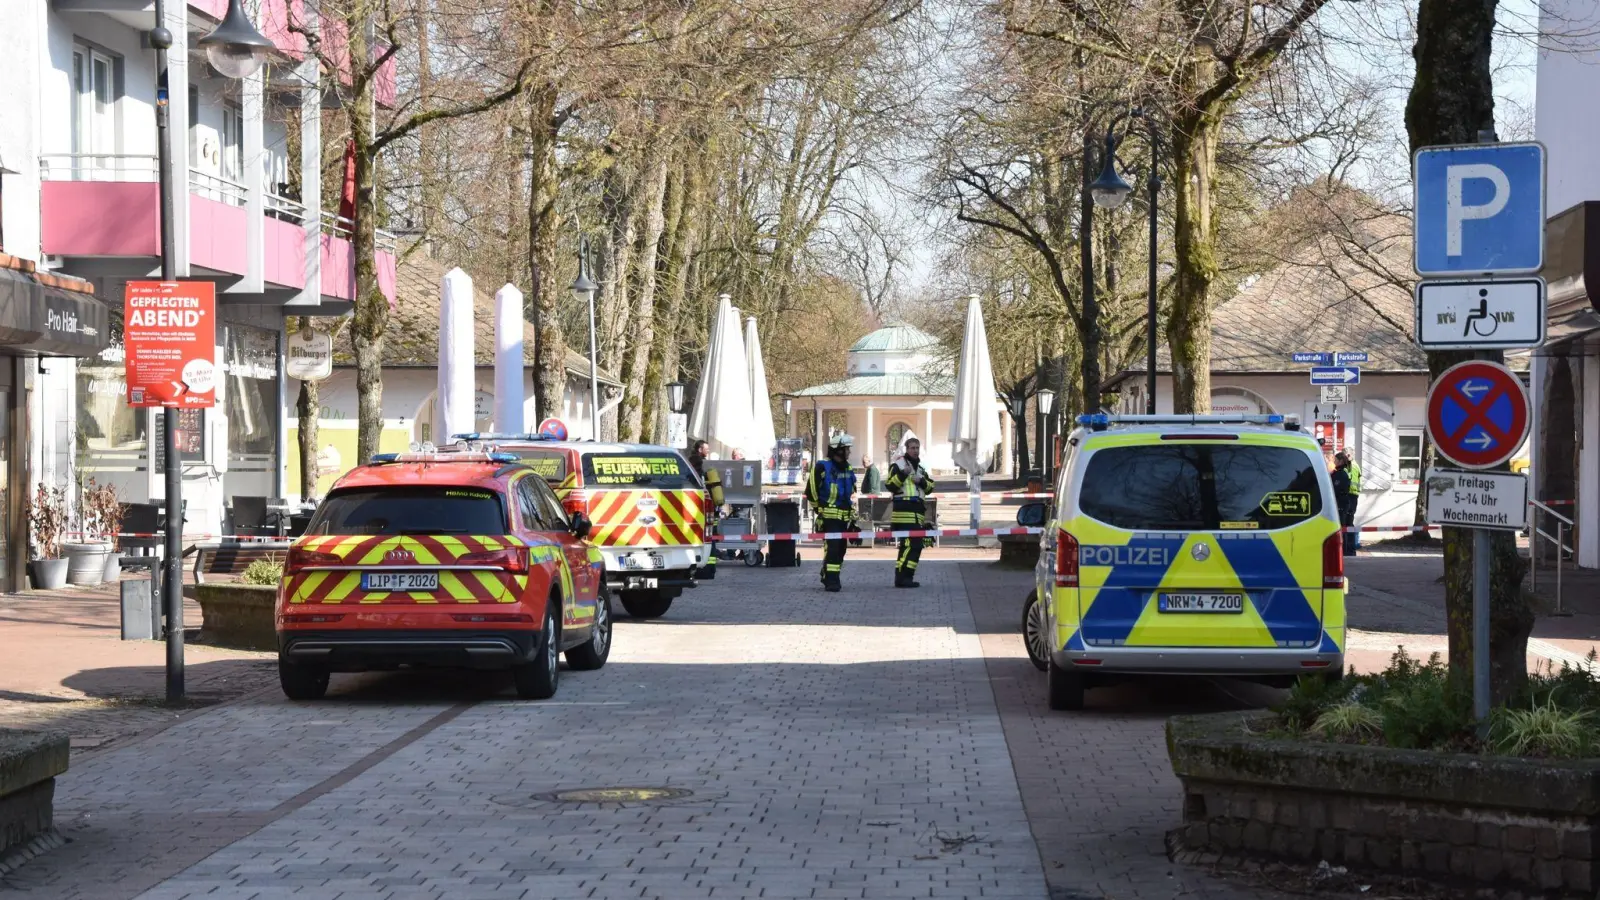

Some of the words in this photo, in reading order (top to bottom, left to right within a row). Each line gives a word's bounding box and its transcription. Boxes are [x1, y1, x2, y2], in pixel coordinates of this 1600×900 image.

[1446, 163, 1511, 257] P
[130, 297, 199, 308] GEPFLEGTEN
[48, 308, 61, 331] Pro
[62, 311, 78, 333] Hair
[291, 346, 327, 360] Bitburger
[1338, 353, 1366, 361] Parkstraße
[399, 416, 405, 424] 2
[593, 462, 680, 475] FEUERWEHR
[1459, 476, 1495, 491] freitags
[1454, 492, 1478, 505] 5-14
[1481, 494, 1497, 506] Uhr
[1443, 508, 1508, 524] Wochenmarkt
[1081, 547, 1168, 565] POLIZEI
[370, 574, 391, 588] LIP
[398, 574, 406, 587] F
[408, 574, 436, 587] 2026
[1166, 596, 1190, 609] NRW
